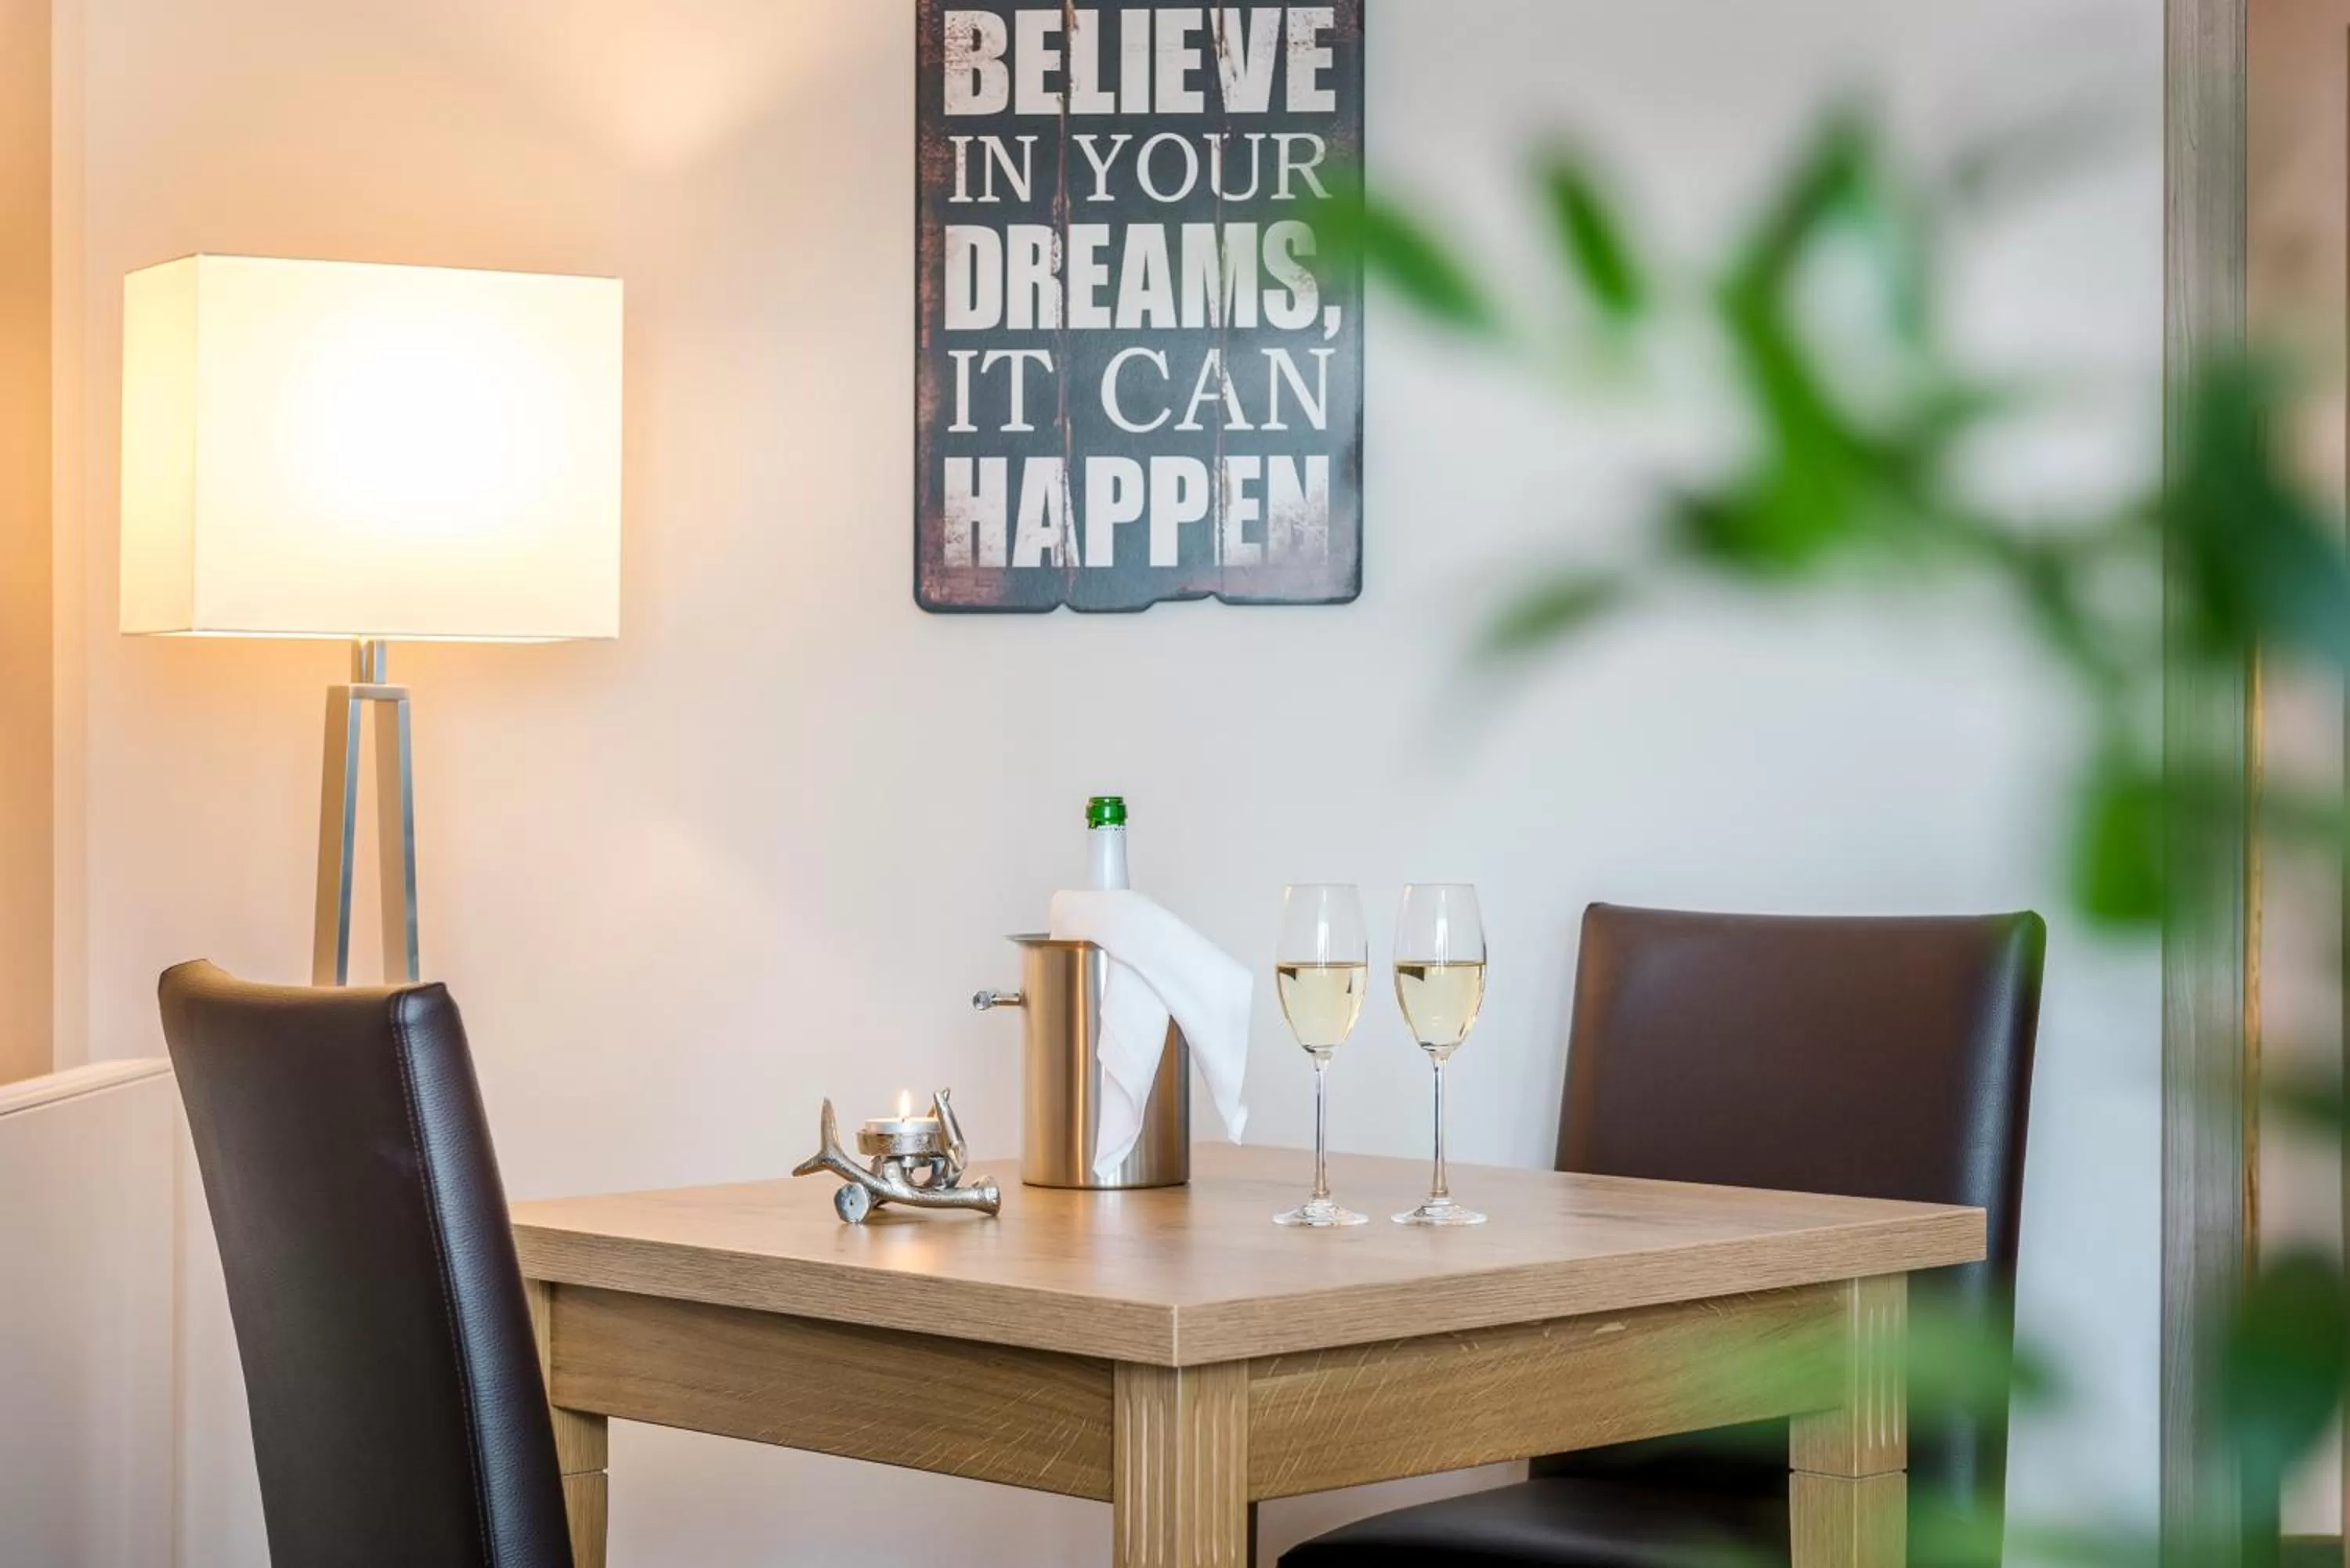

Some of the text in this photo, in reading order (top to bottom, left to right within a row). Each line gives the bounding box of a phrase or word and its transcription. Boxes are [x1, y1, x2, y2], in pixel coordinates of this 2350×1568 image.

[944, 7, 1336, 116] BELIEVE
[948, 132, 1332, 203] IN YOUR
[945, 219, 1342, 340] DREAMS,
[947, 347, 1336, 433] IT CAN
[944, 455, 1329, 568] HAPPEN
